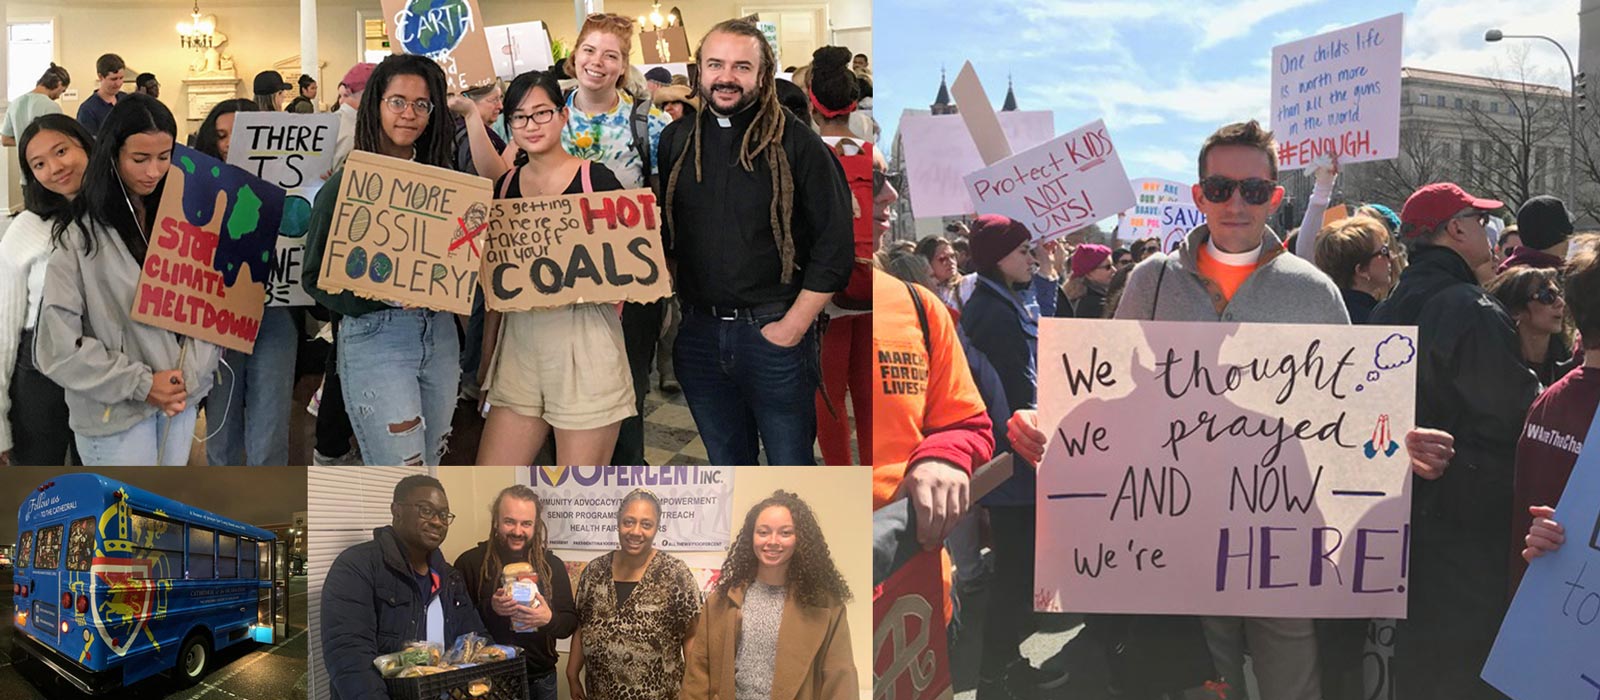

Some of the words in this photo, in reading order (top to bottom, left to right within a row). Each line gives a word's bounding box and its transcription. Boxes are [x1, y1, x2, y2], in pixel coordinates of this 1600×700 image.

[394, 4, 475, 43] EARTH
[1280, 54, 1305, 75] One
[1314, 39, 1350, 63] child's
[1356, 28, 1384, 50] life
[1278, 103, 1300, 121] than
[1306, 96, 1322, 111] all
[1329, 89, 1347, 104] the
[1354, 81, 1381, 105] guns
[1281, 84, 1290, 98] is
[1299, 71, 1332, 93] worth
[1338, 65, 1368, 83] more
[246, 125, 328, 152] THERE
[1289, 122, 1298, 136] in
[1304, 116, 1322, 129] the
[1328, 105, 1361, 126] world
[974, 152, 1064, 202] Protect
[1065, 128, 1113, 165] KIDS
[1278, 130, 1378, 166] #ENOUGH.
[346, 170, 383, 201] NO
[389, 178, 457, 215] MORE
[1024, 174, 1069, 217] NOT
[1032, 190, 1096, 234] UNS!
[334, 202, 441, 259] FOSSIL
[512, 199, 571, 214] getting
[580, 194, 656, 235] HOT
[559, 217, 579, 232] so
[157, 216, 219, 268] STOP
[487, 249, 509, 263] all
[513, 244, 549, 263] your
[145, 254, 226, 299] CLIMATE
[326, 240, 478, 302] FOOLERY!
[492, 237, 659, 300] COALS
[138, 283, 259, 343] MELTDOWN
[878, 350, 926, 366] MARCH
[880, 365, 910, 379] FOR
[1062, 346, 1117, 396] We
[1154, 339, 1356, 405] thought
[883, 381, 919, 395] LIVES
[1161, 410, 1357, 467] prayed
[700, 469, 724, 485] INC.
[1109, 465, 1192, 521] AND
[1229, 465, 1323, 514] NOW
[547, 511, 574, 519] SENIOR
[570, 524, 600, 532] HEALTH
[1073, 539, 1167, 578] We're
[1215, 524, 1410, 594] HERE!
